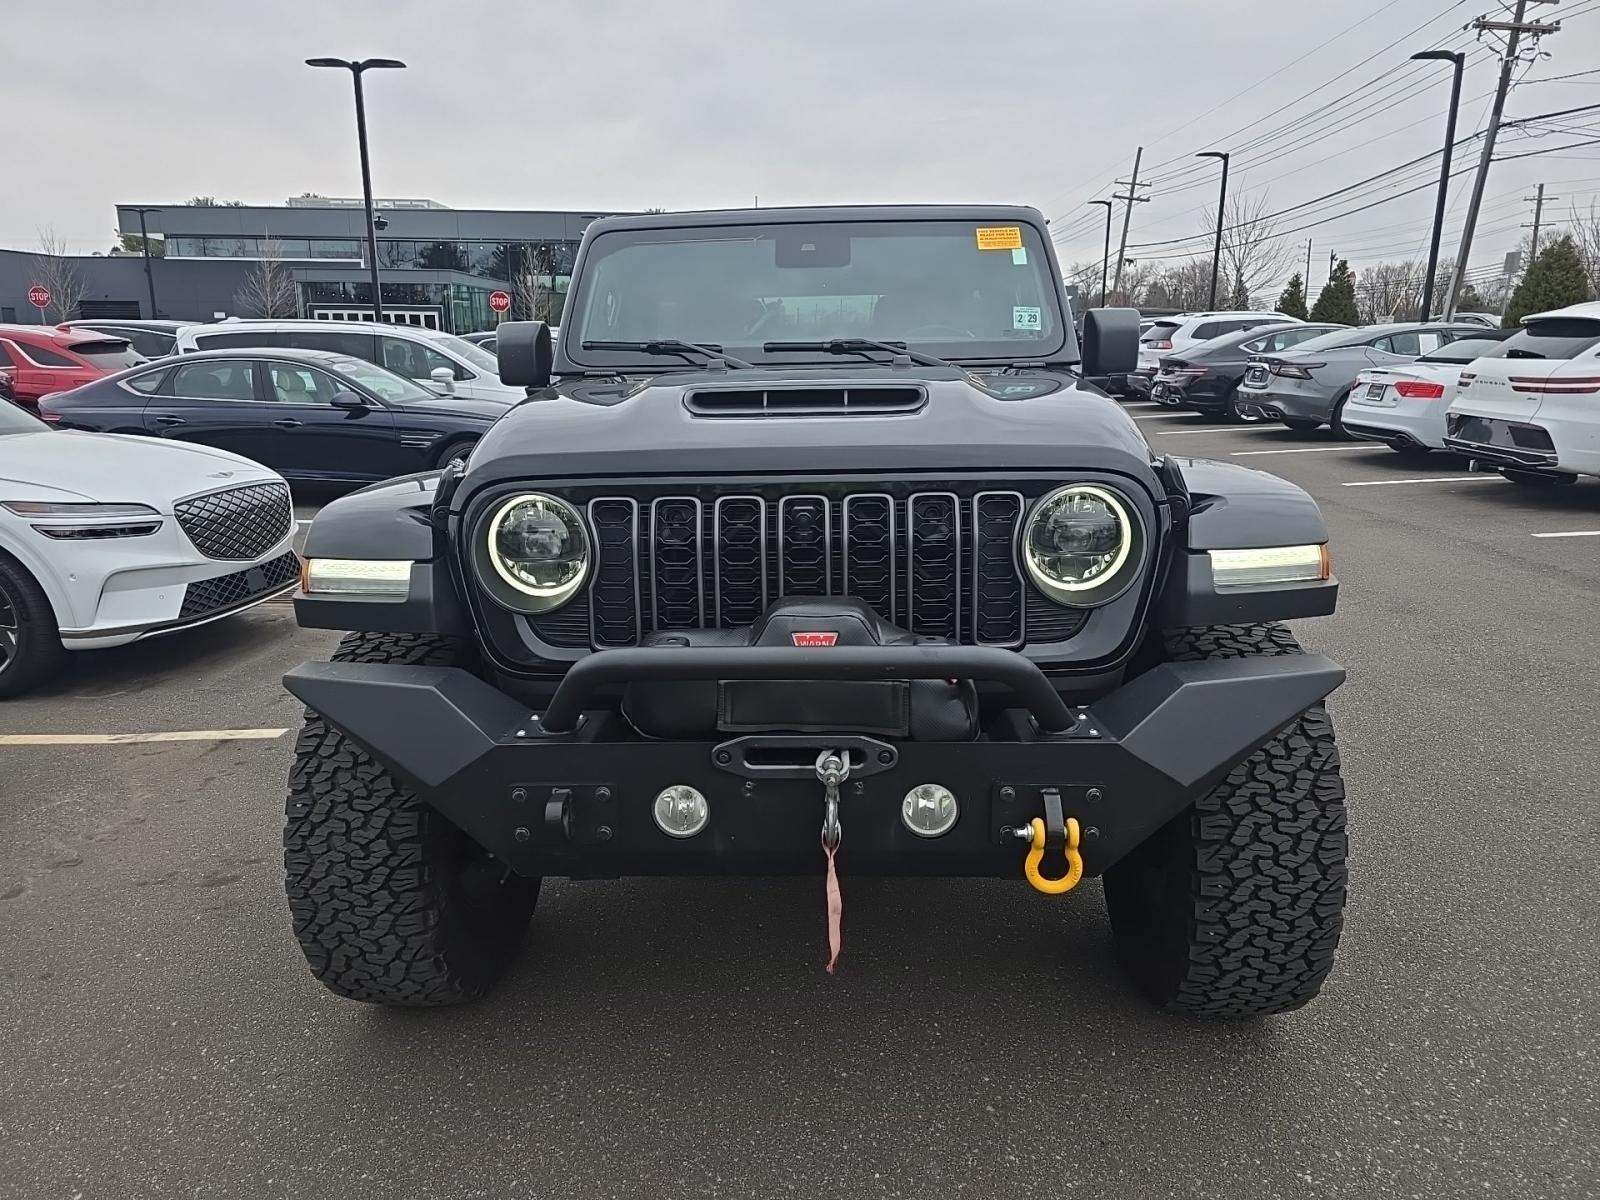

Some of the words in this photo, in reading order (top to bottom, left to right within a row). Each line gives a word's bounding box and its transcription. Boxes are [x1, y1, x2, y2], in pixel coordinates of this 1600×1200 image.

[31, 292, 48, 301] STOP
[491, 297, 508, 306] STOP
[1018, 314, 1023, 323] 2
[1028, 313, 1038, 323] 29
